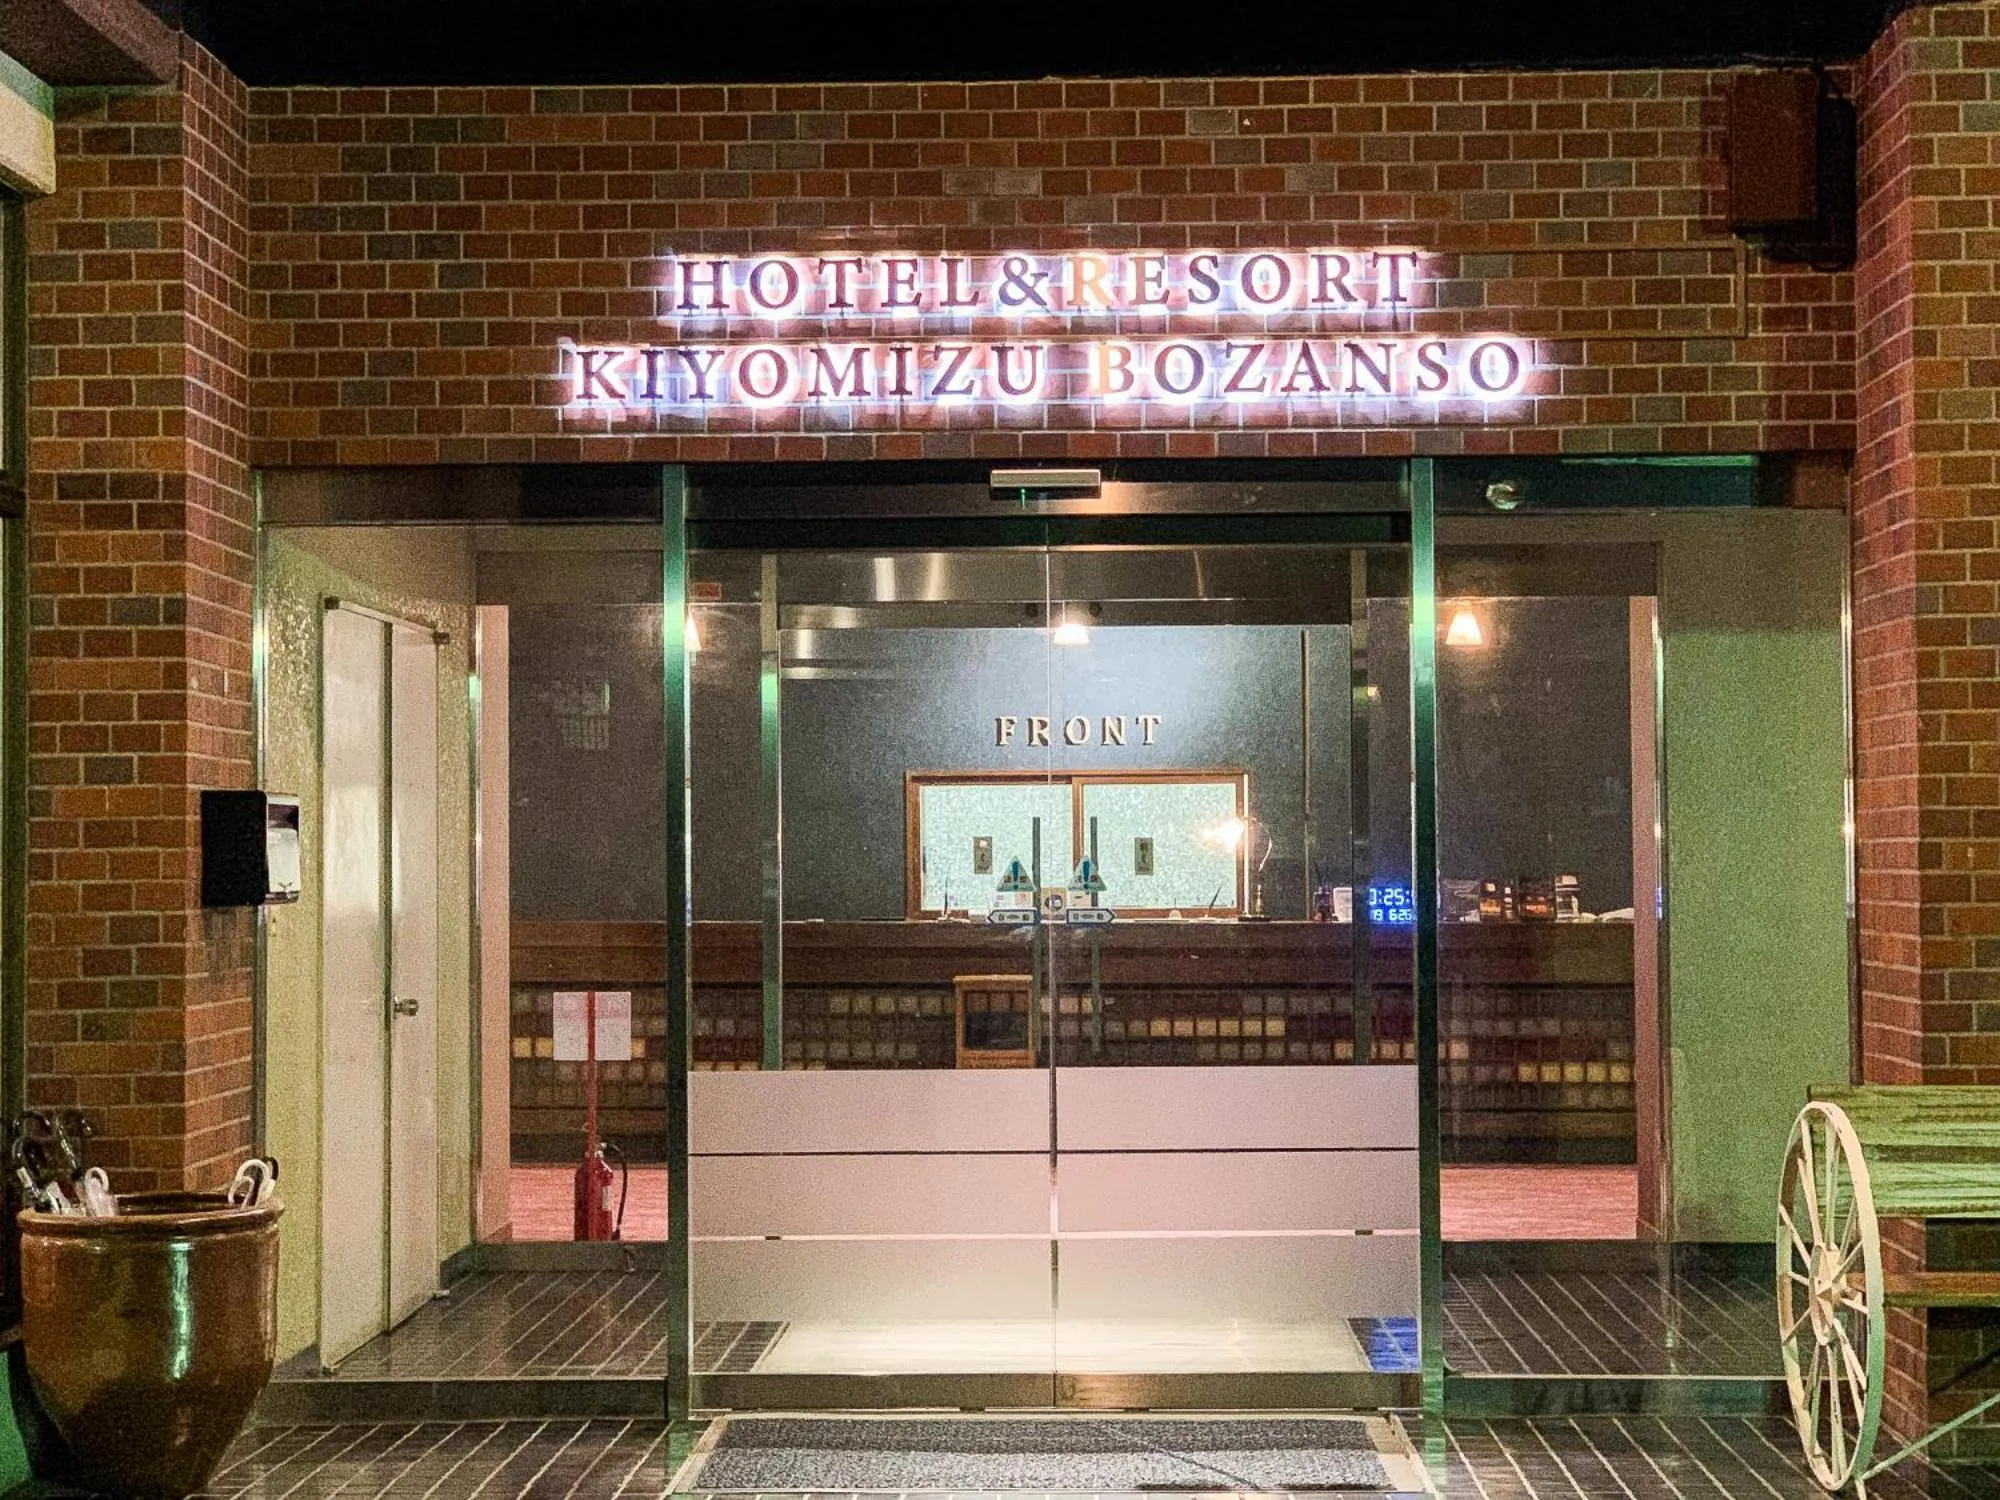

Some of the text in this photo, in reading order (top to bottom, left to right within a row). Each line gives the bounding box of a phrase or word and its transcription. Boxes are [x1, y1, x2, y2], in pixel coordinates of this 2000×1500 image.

[575, 341, 1521, 400] KIYOMIZU BOZANSO
[994, 715, 1162, 746] FRONT
